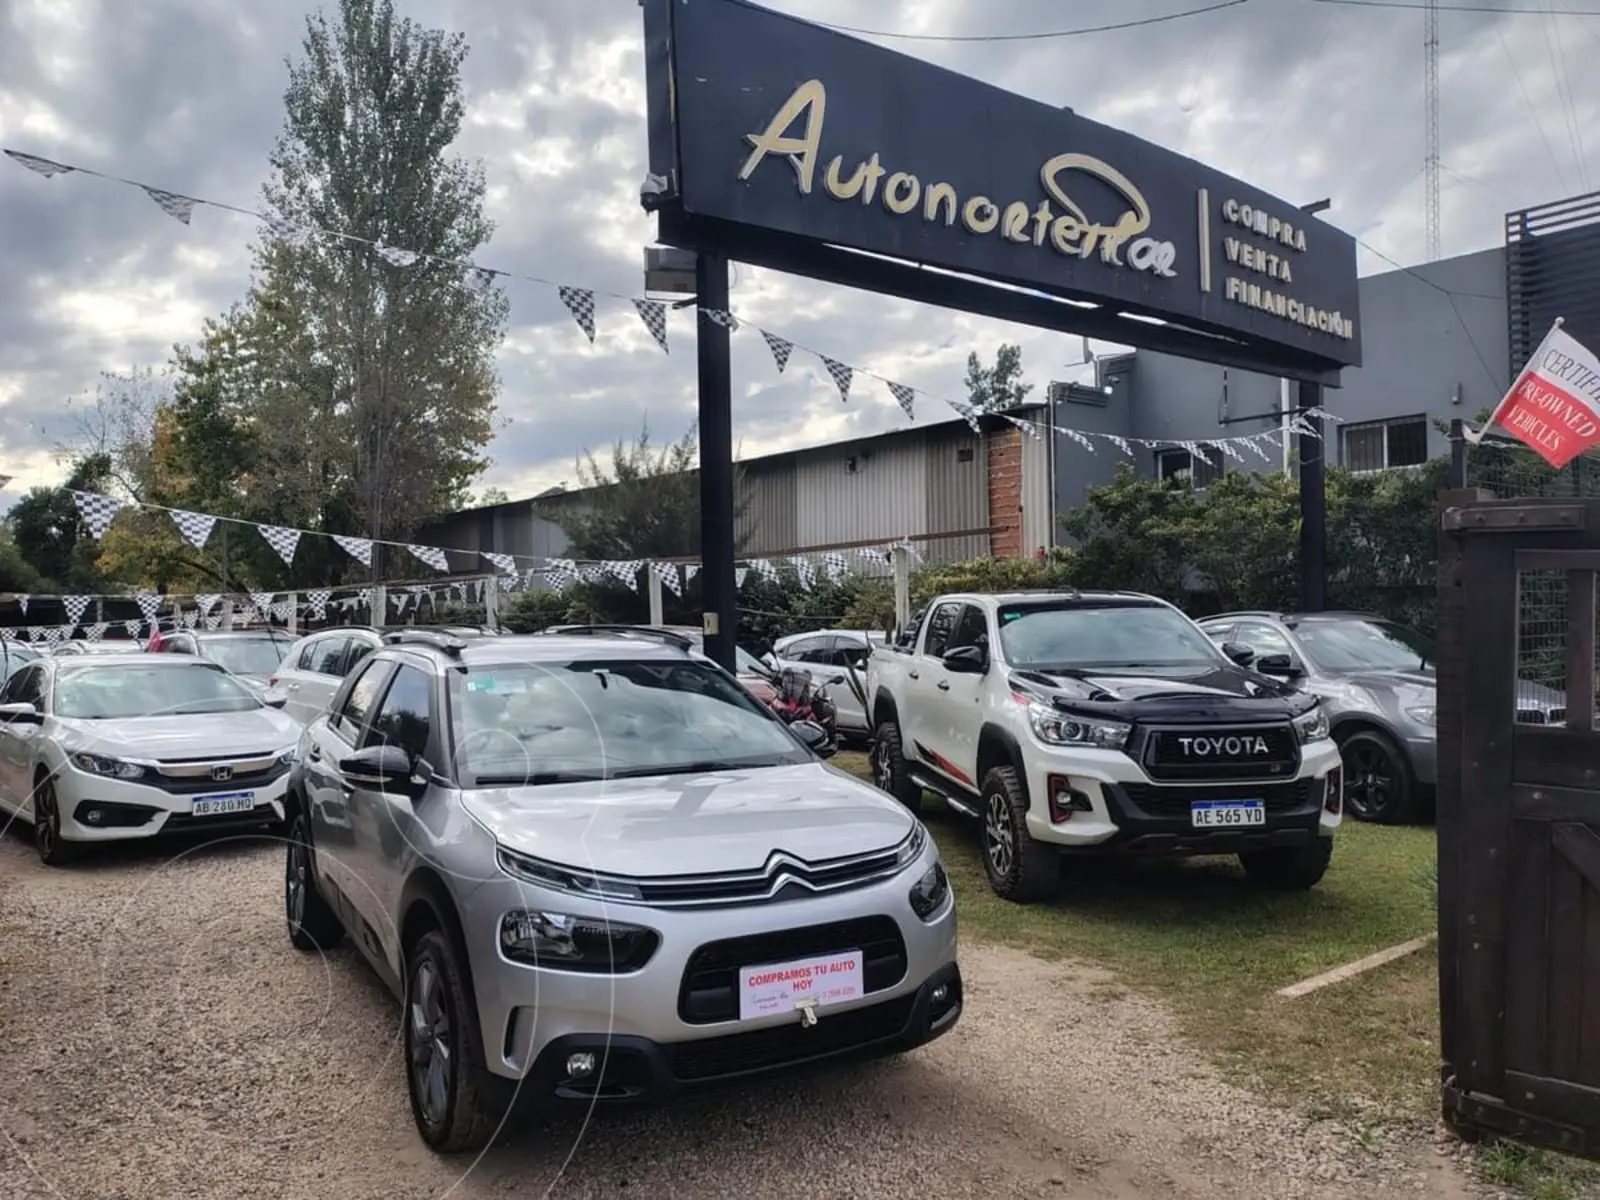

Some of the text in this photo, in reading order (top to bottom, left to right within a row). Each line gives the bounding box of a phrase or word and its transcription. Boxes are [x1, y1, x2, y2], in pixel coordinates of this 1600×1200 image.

[1222, 198, 1308, 253] COMPRA
[1224, 236, 1292, 283] VENTA
[1178, 736, 1269, 756] TOYOTA
[195, 803, 209, 813] AB
[1196, 808, 1262, 824] AE 565 YD
[748, 959, 856, 987] COMPRAMOS TU AUTO
[792, 979, 813, 992] HOY
